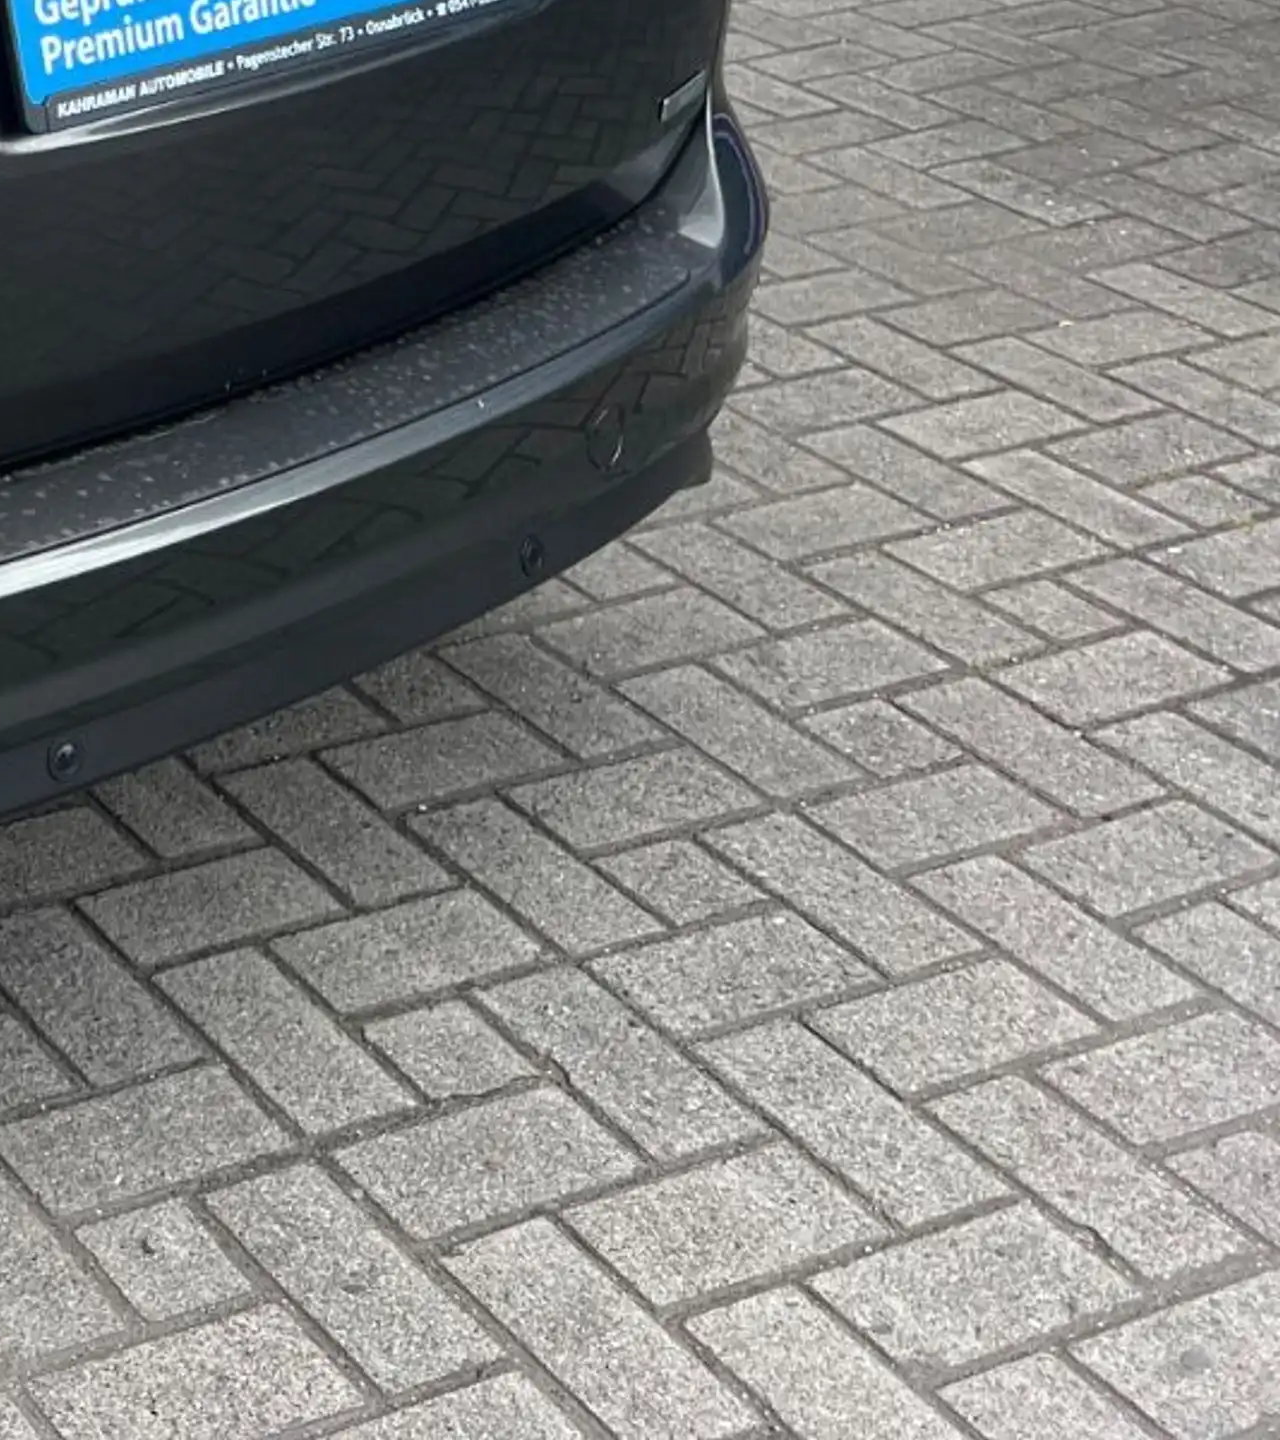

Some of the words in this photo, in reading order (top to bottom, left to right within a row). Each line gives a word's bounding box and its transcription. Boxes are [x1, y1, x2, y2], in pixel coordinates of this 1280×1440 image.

[41, 14, 184, 75] Premium
[58, 84, 137, 118] KAHRAMAN
[139, 60, 225, 97] AUTOMOBILE
[236, 38, 312, 71] Pagenstecher
[339, 26, 355, 43] 73
[365, 8, 425, 35] Osnabrück
